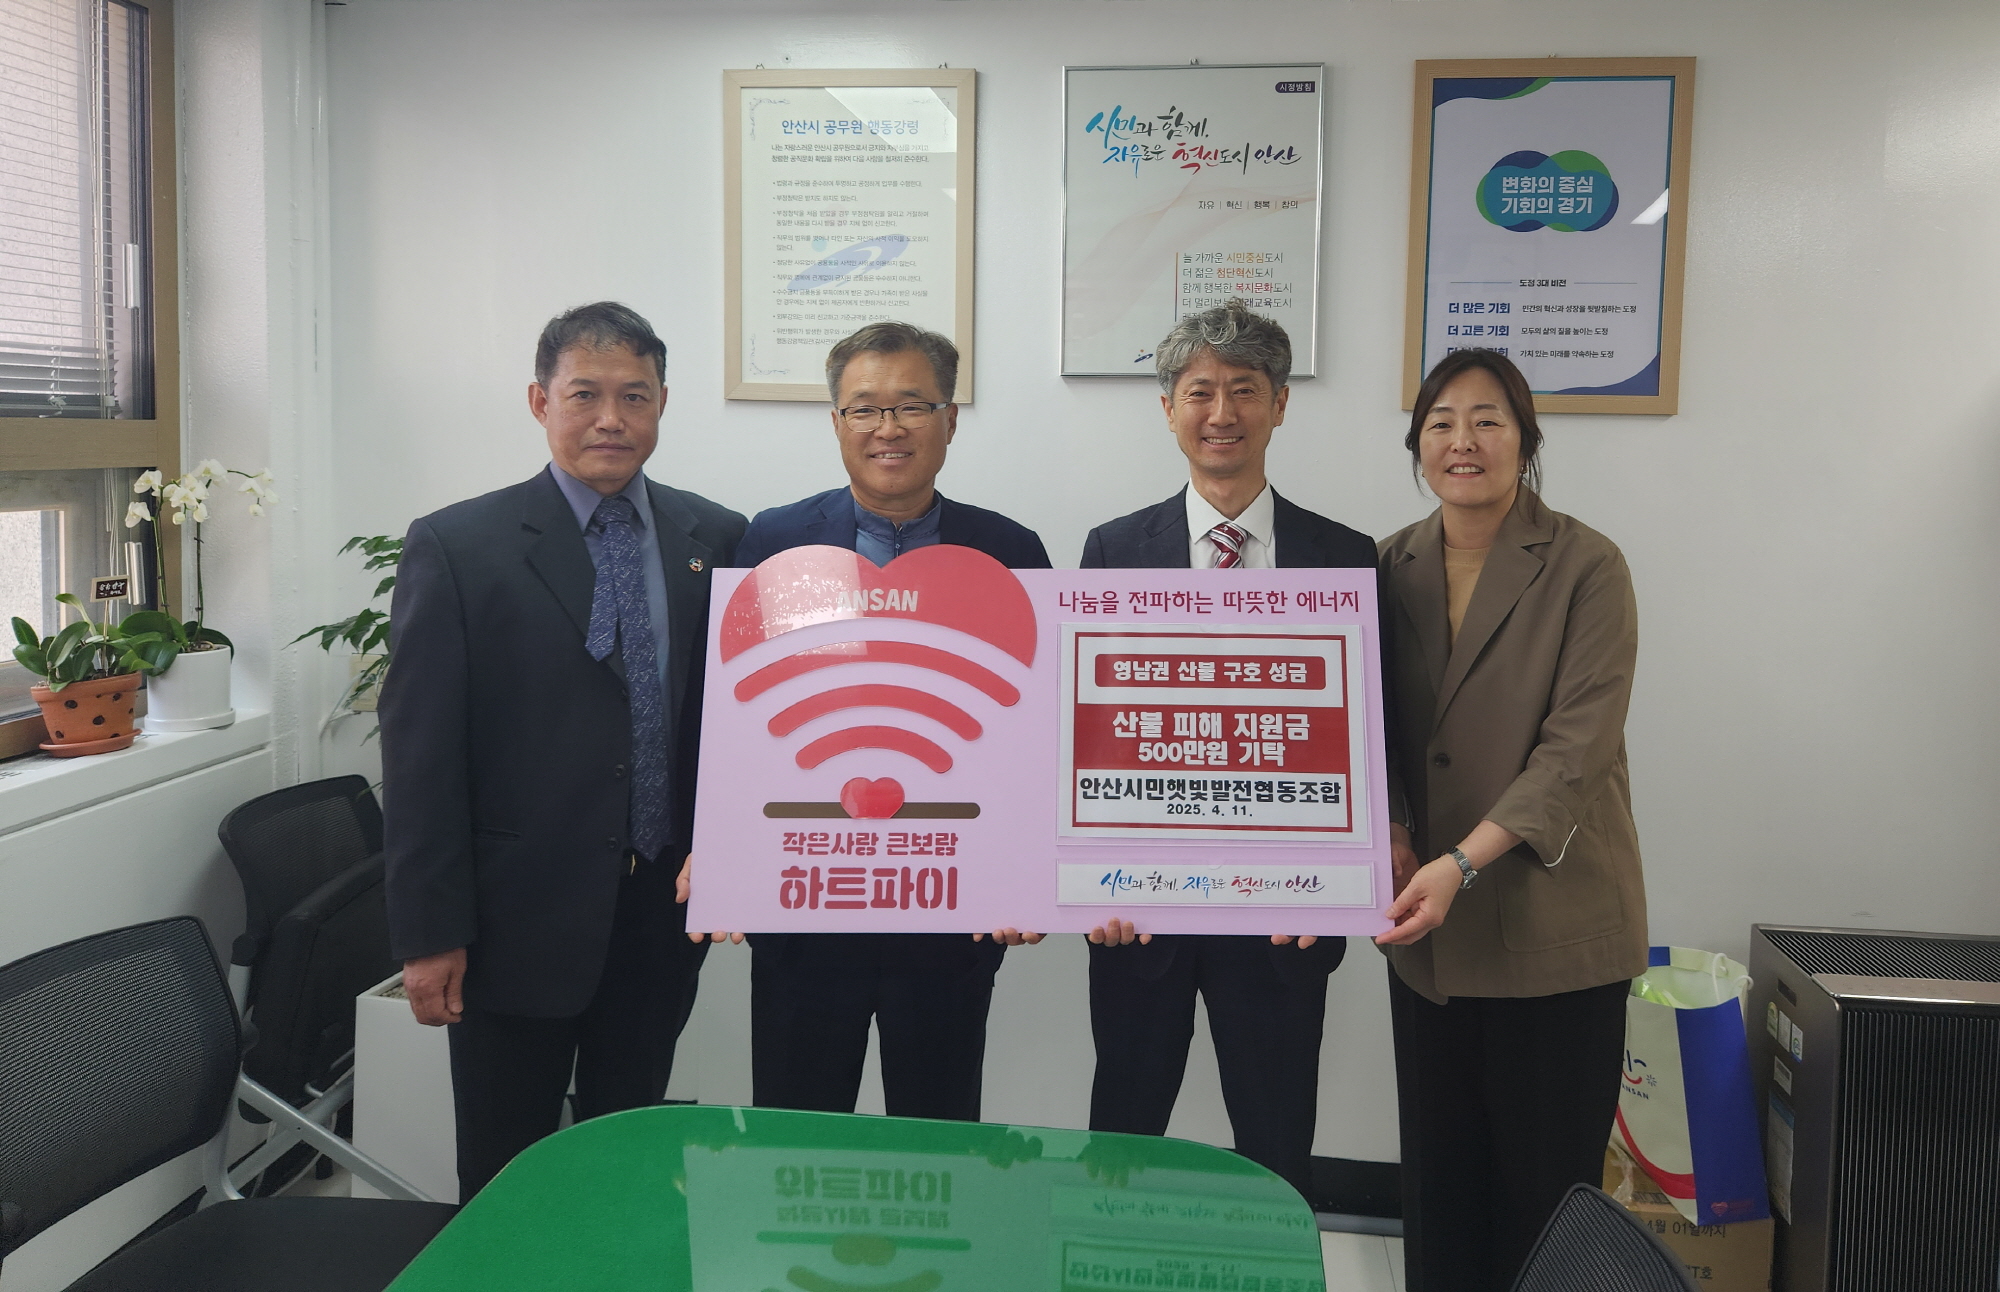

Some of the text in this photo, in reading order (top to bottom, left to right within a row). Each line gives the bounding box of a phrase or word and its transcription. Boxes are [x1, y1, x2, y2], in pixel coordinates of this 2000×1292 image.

[1280, 83, 1312, 92] 시정방침
[782, 120, 919, 135] 안산시 공무원 행동강령
[1086, 105, 1157, 148] 시민과
[1103, 142, 1302, 178] 자유로운 혁신도시 안산
[1502, 176, 1594, 193] 변화의 중심
[1198, 200, 1298, 209] 자유 혁신 행복 창의
[1502, 197, 1592, 214] 기회의 경기
[1183, 252, 1283, 263] 늘 가까운 시민중심도시
[1183, 268, 1273, 278] 더 젊은 첨단혁신도시
[1183, 283, 1292, 293] 함께 행복한 복지문화도시
[1519, 279, 1566, 287] 도정 3대 비전
[1183, 298, 1191, 308] 더
[1449, 303, 1510, 314] 더 많은 기회
[1522, 305, 1542, 313] 민간의
[1544, 305, 1564, 313] 혁신과
[1566, 305, 1586, 313] 성장을
[1622, 305, 1636, 313] 도정
[1448, 325, 1509, 336] 더 고른 기회
[1521, 327, 1608, 335] 모두의 삶의 질을 높이는 도정
[1520, 350, 1614, 358] 가치 있는 미래를 약속하는 도정
[837, 588, 918, 612] ANSAN
[1059, 591, 1360, 614] 나눔을 전파하는 따뜻한 에너지
[1113, 661, 1307, 683] 영남권 산불 구호 성금
[1112, 711, 1310, 741] 산불 피해 지원금
[1138, 741, 1286, 766] 500만원 기탁
[1080, 777, 1341, 804] 안산시민햇빛발전협동조합
[1167, 804, 1253, 817] 2025. 4. 11.
[782, 832, 958, 856] 작은사랑 큰보람
[780, 866, 958, 910] 하트파이
[1100, 869, 1146, 897] 시민과
[1183, 876, 1226, 899] 자유로운
[1231, 875, 1280, 897] 혁신도시
[1285, 875, 1325, 892] 안산
[1685, 1265, 1713, 1279] T호
